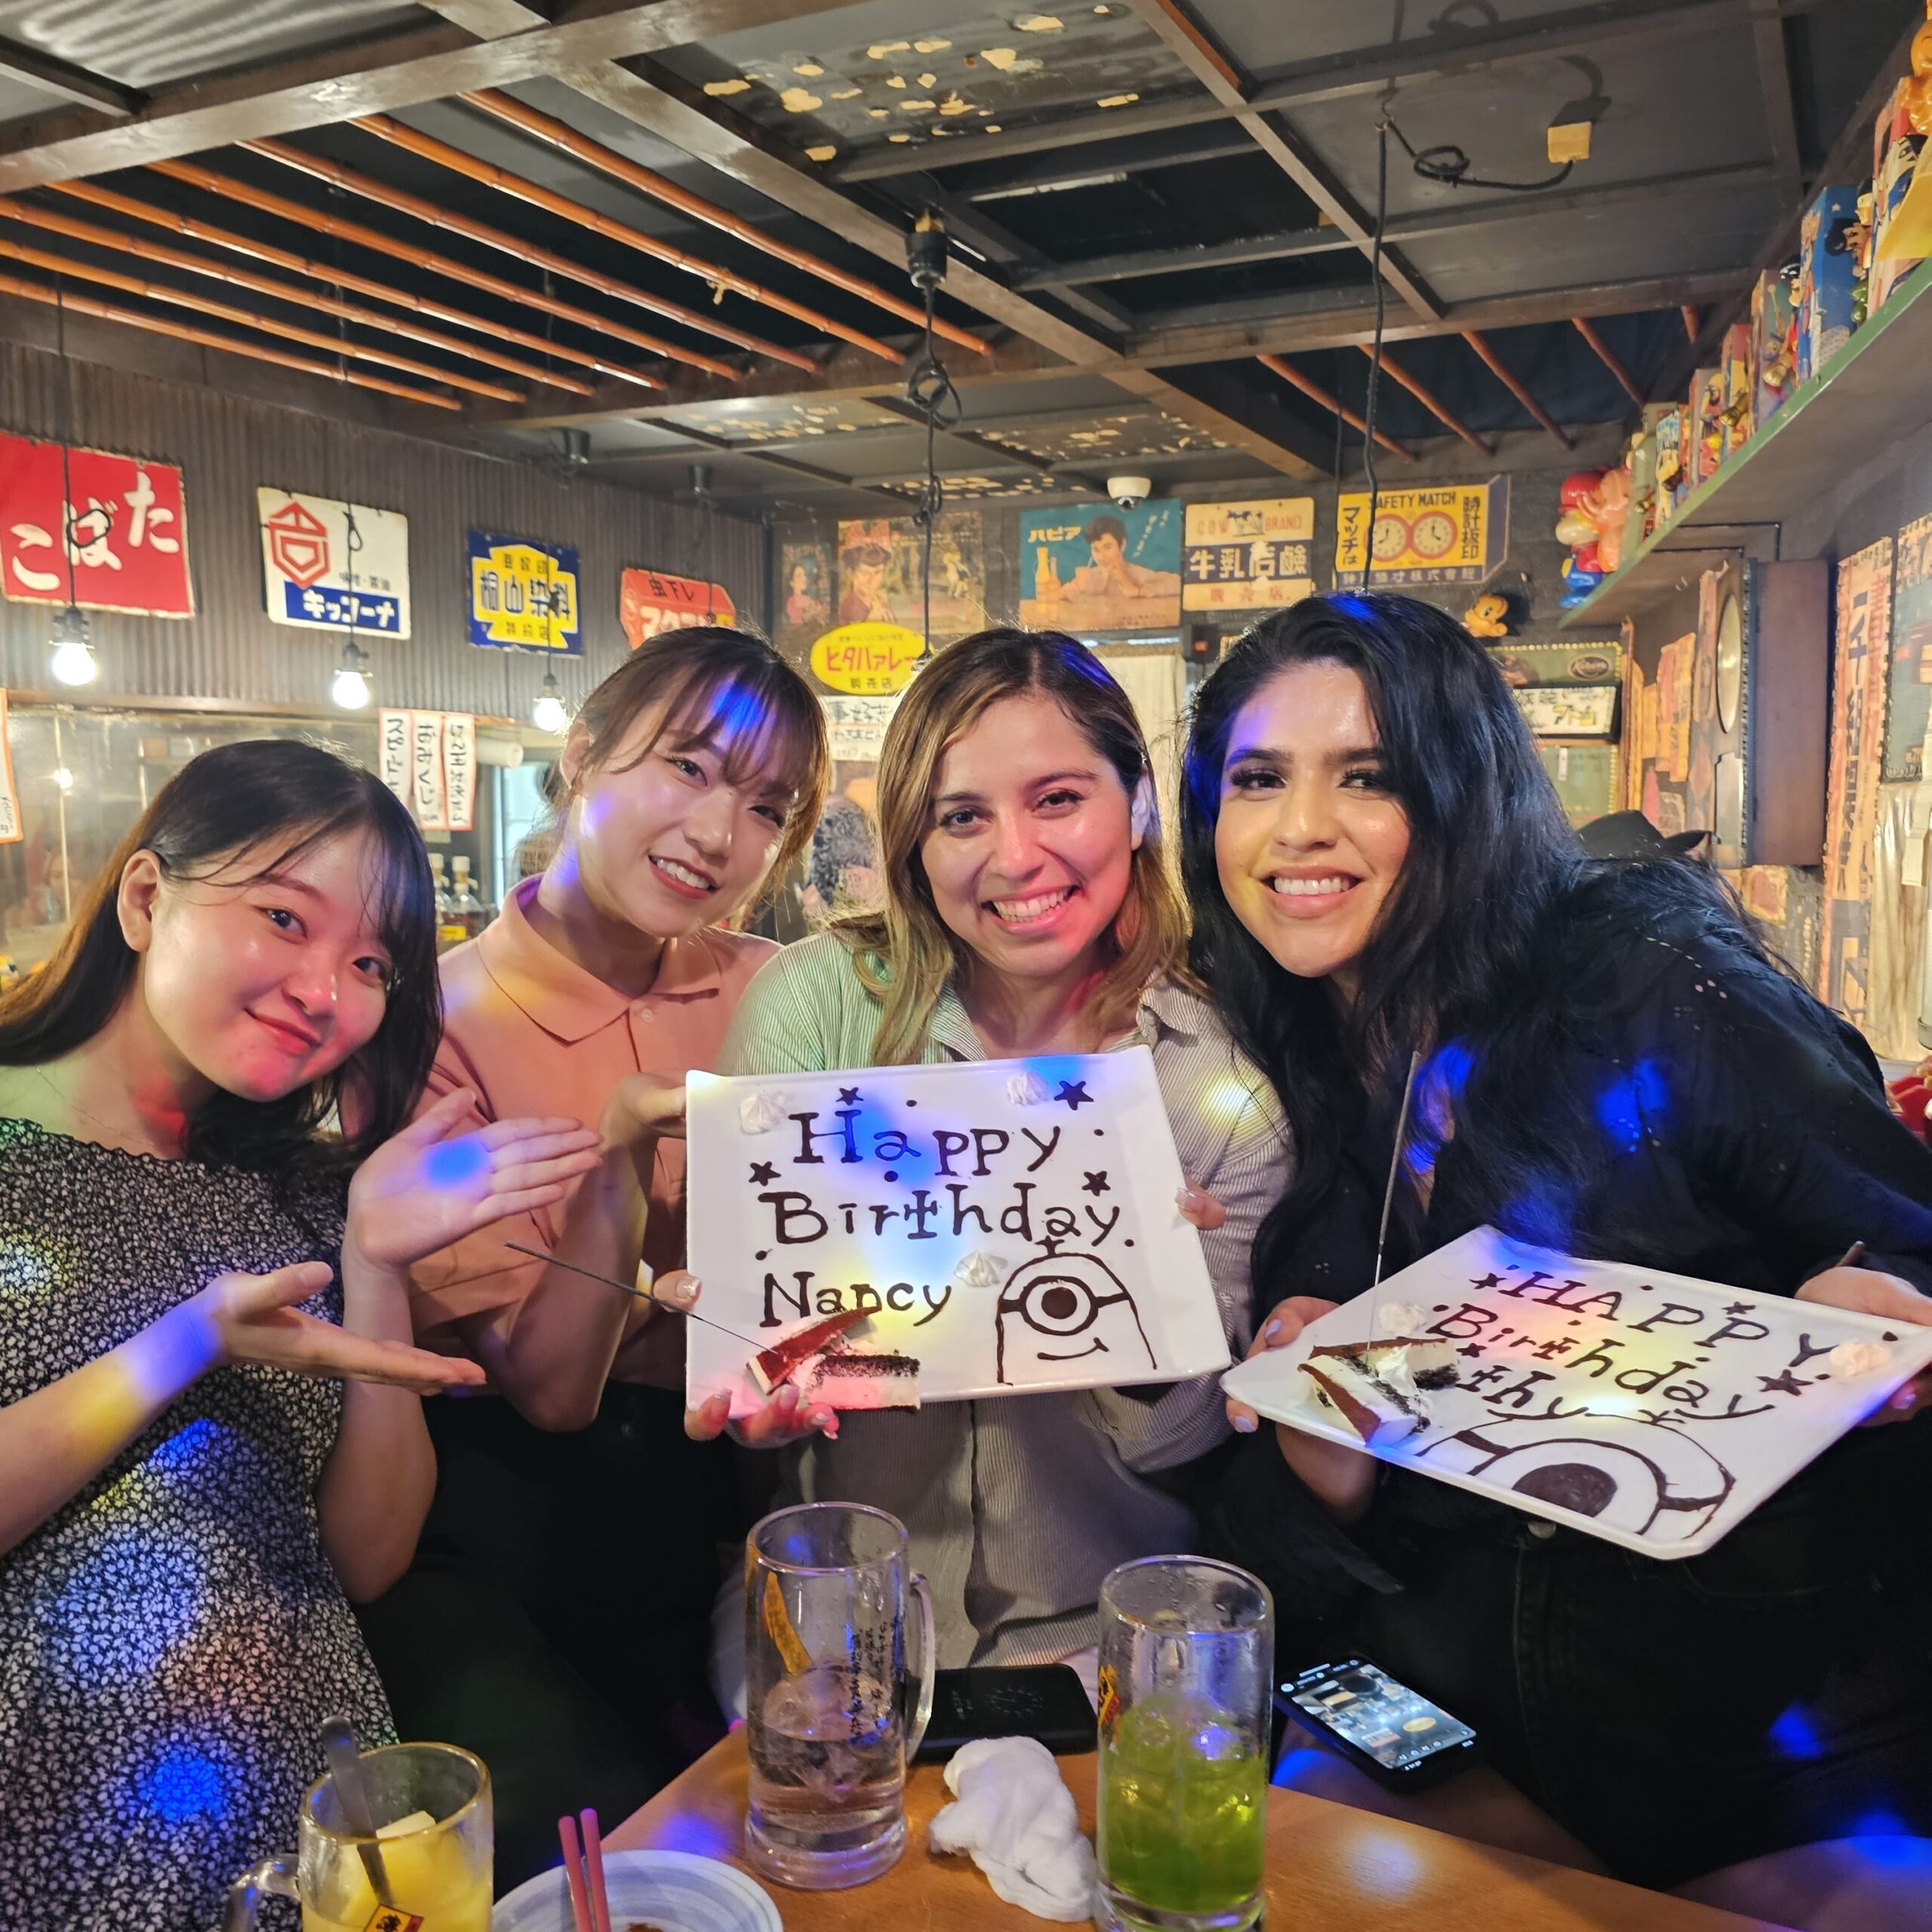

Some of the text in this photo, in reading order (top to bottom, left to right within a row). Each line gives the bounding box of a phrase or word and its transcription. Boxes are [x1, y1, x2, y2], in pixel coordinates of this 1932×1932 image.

[1197, 515, 1303, 536] COW BRAND
[1369, 491, 1457, 510] AFETY MATCH
[10, 471, 180, 591] たばこ
[1342, 506, 1361, 565] マッチは
[302, 590, 395, 628] キッコーナ
[789, 1109, 1060, 1176] Happy
[759, 1271, 952, 1327] Nancy
[1499, 1271, 1839, 1367] HAPPY
[1426, 1303, 1776, 1420] Birthday
